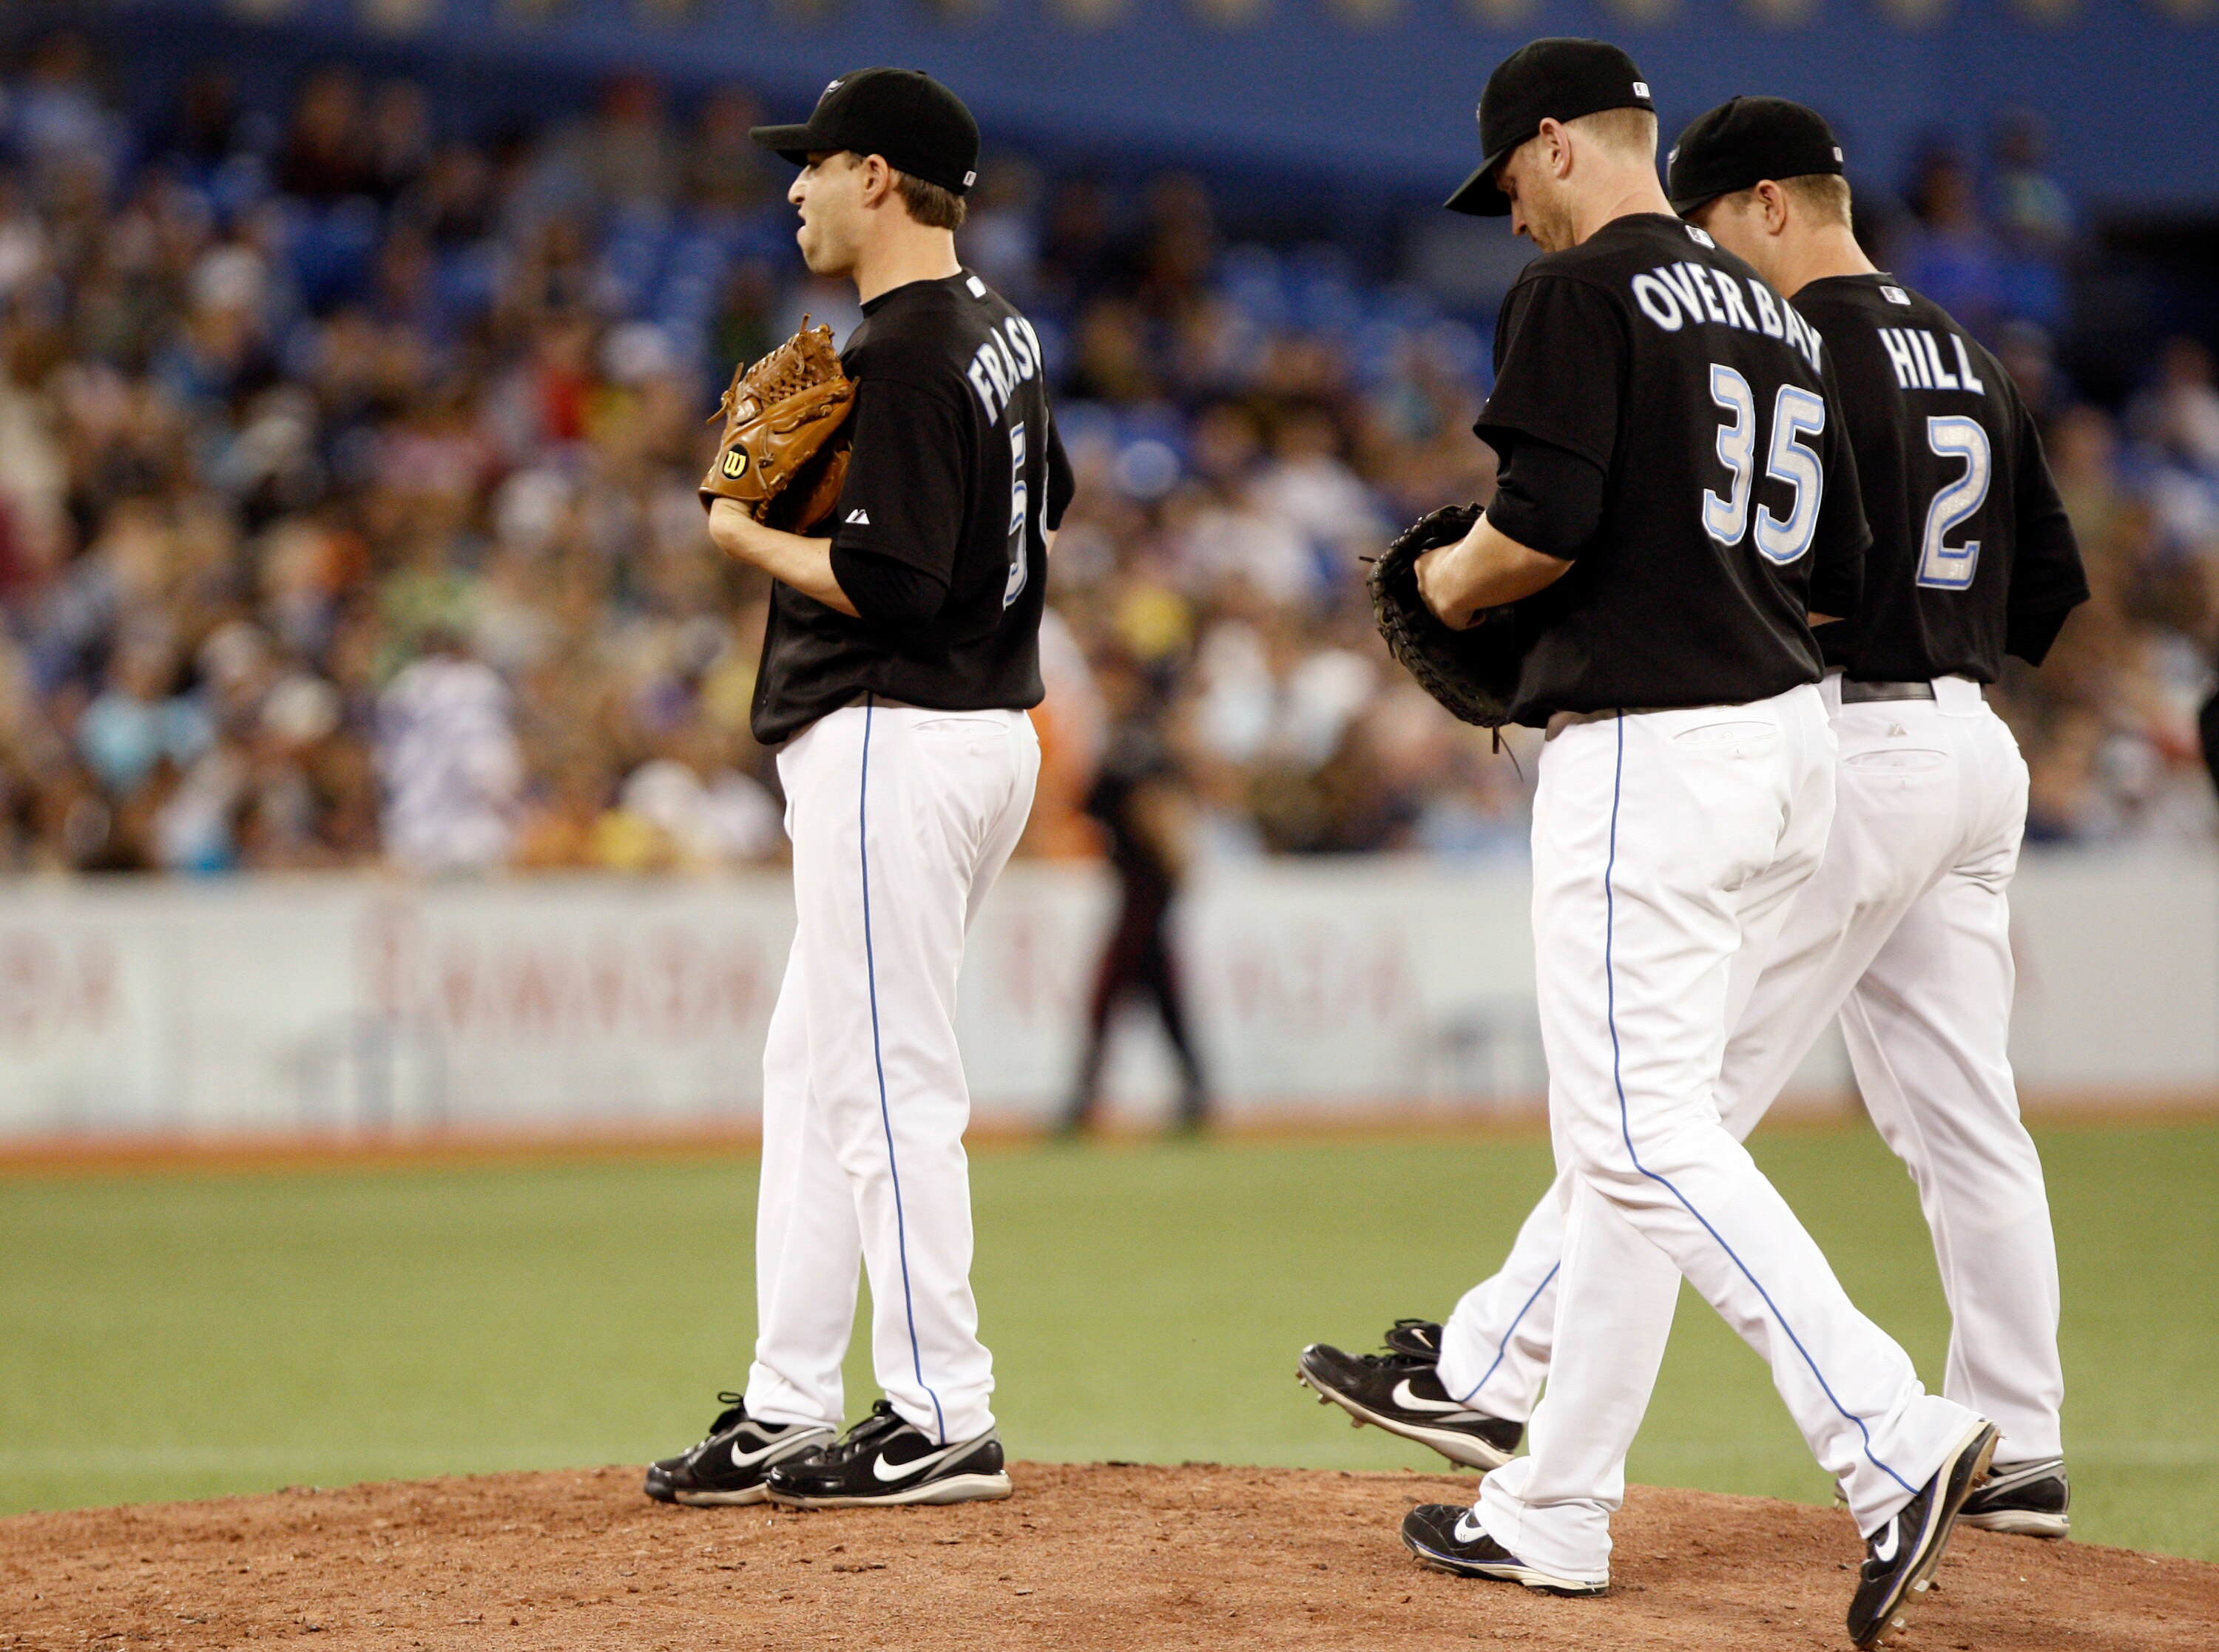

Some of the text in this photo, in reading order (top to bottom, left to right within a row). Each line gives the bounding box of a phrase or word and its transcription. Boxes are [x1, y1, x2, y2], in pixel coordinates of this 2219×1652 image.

[1631, 261, 1823, 376] OVERBAY
[1878, 327, 1985, 396] HILL
[1702, 362, 1825, 566] 35
[1916, 414, 1992, 592] 2
